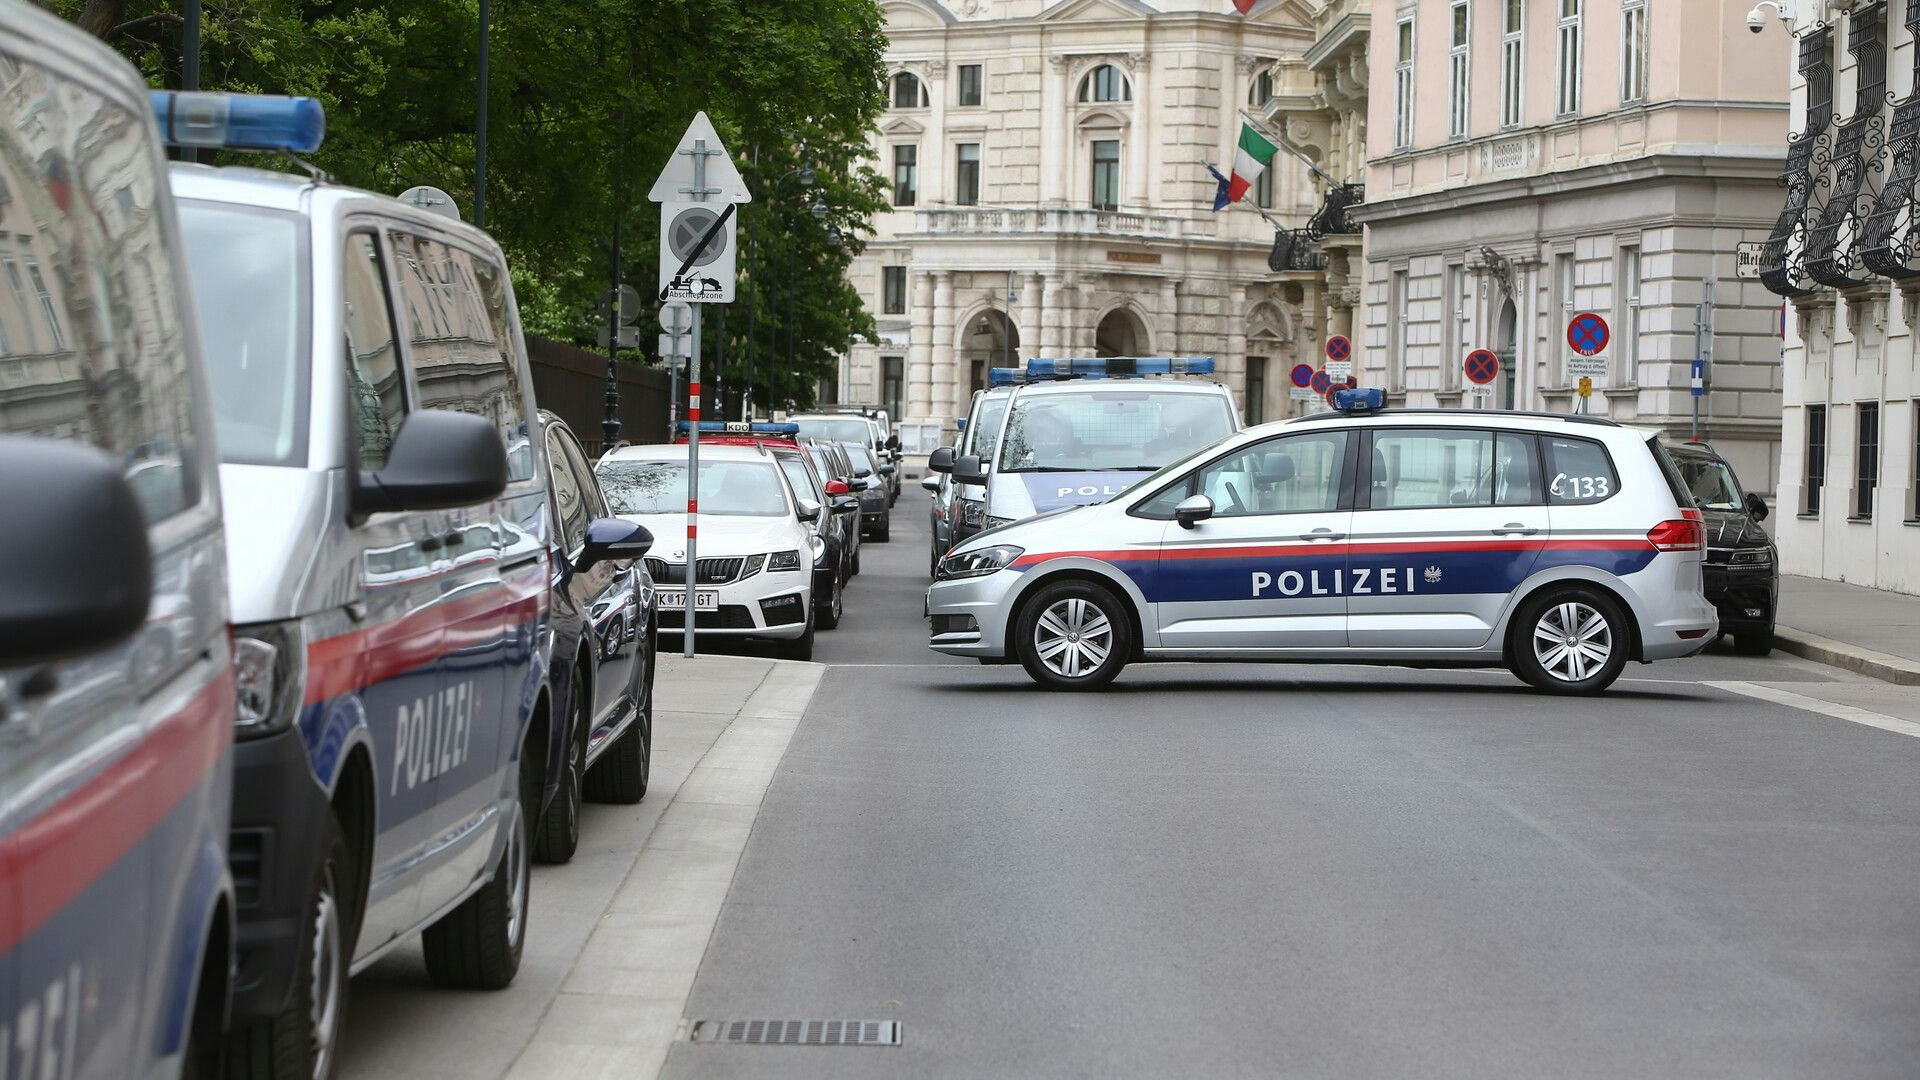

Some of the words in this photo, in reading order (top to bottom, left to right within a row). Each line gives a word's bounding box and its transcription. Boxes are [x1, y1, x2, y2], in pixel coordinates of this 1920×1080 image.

[727, 423, 749, 431] KDO
[1569, 476, 1609, 498] 133
[1251, 567, 1414, 597] POLIZEI
[675, 593, 687, 606] 17
[697, 594, 712, 606] GT
[390, 680, 473, 797] POLIZEI
